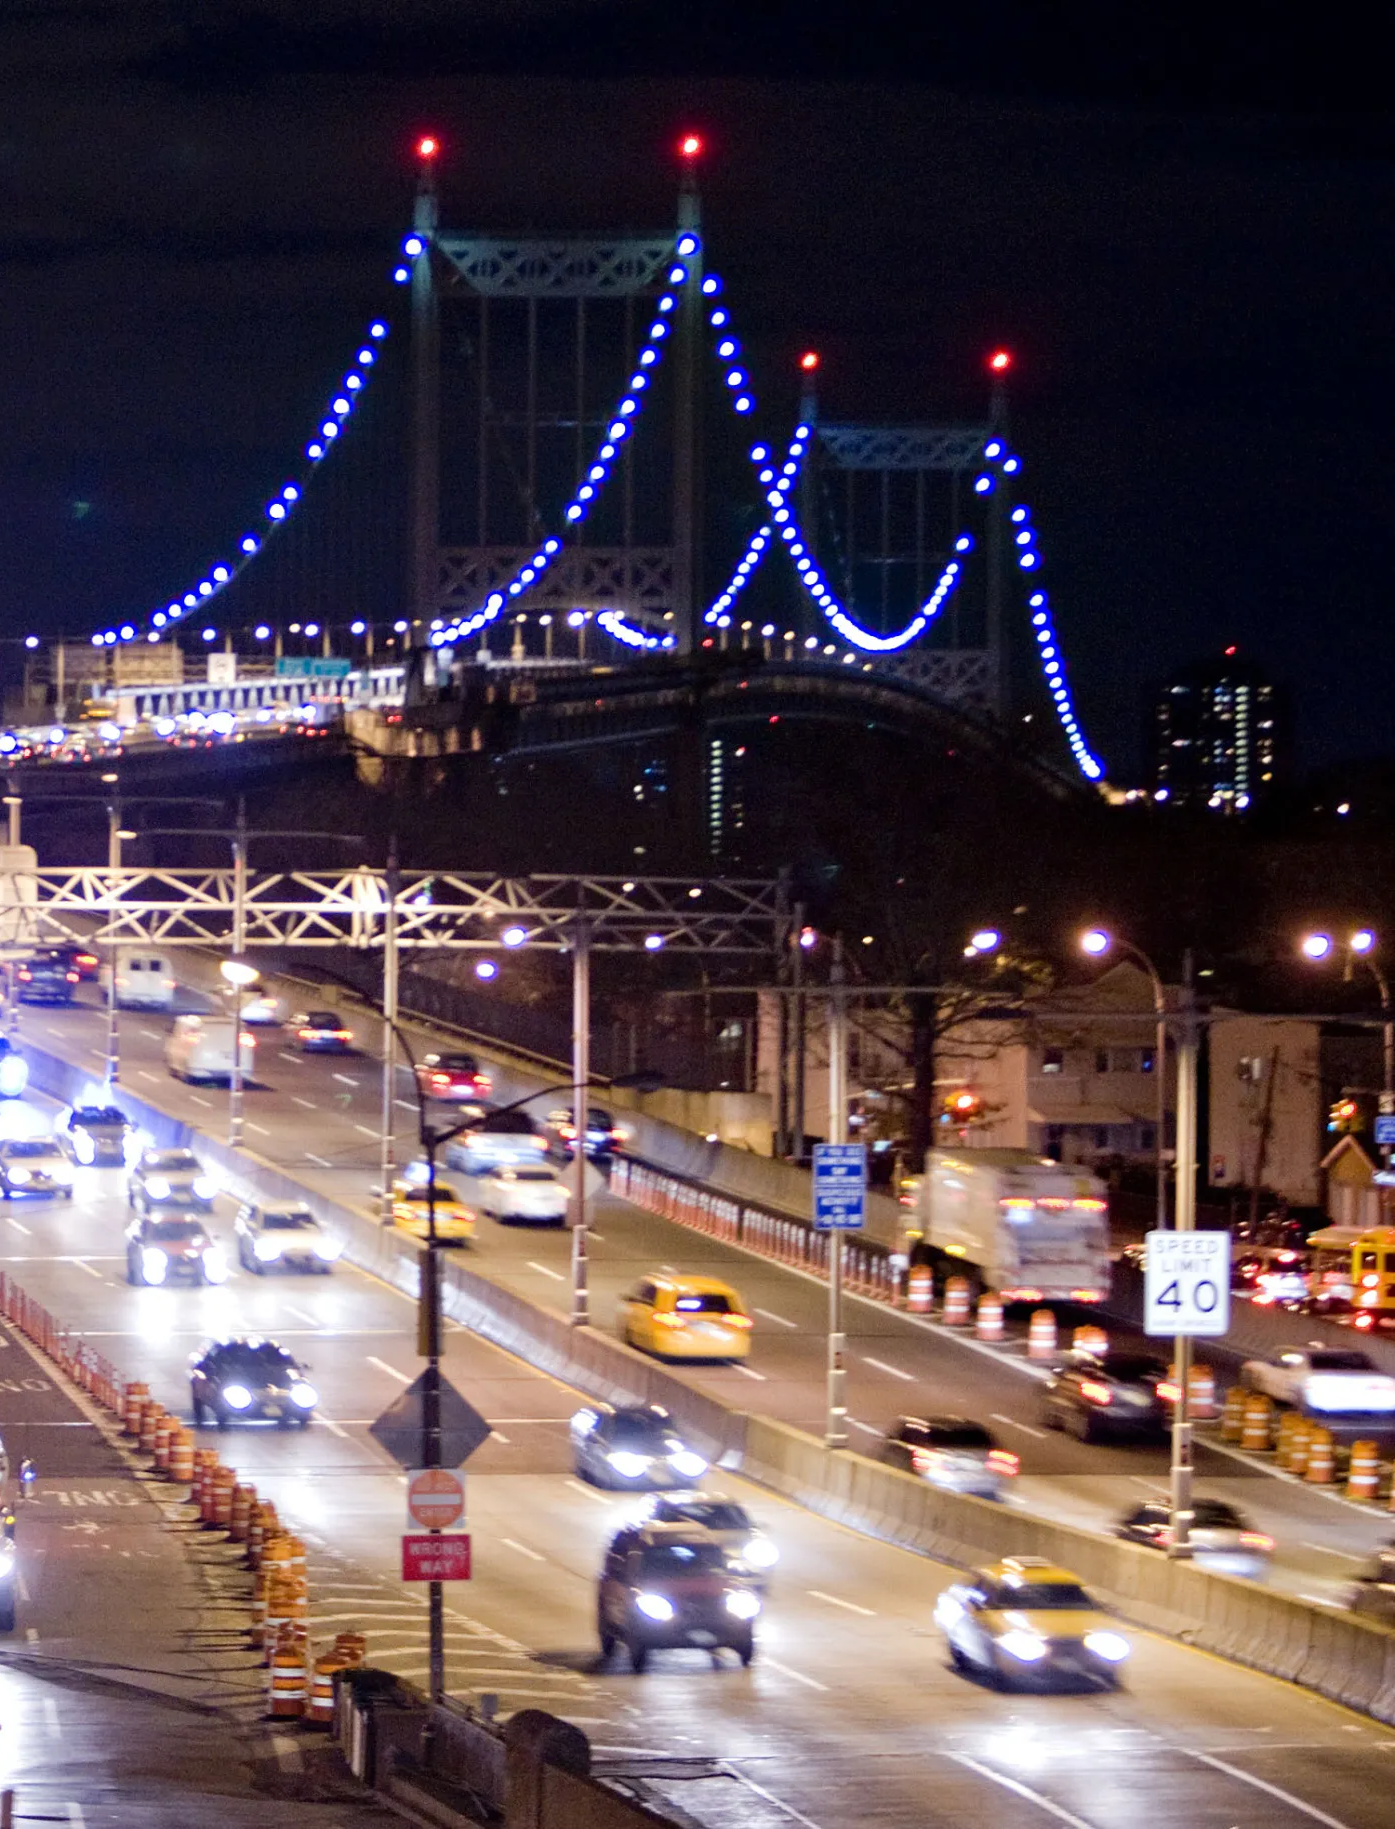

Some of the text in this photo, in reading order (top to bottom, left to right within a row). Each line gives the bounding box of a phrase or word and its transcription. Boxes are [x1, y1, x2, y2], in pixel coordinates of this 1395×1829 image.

[1156, 1239, 1219, 1254] SPEED
[1161, 1258, 1212, 1273] LIMIT
[1155, 1279, 1219, 1313] 40
[409, 1543, 466, 1555] WRONG
[420, 1560, 453, 1573] WAY
